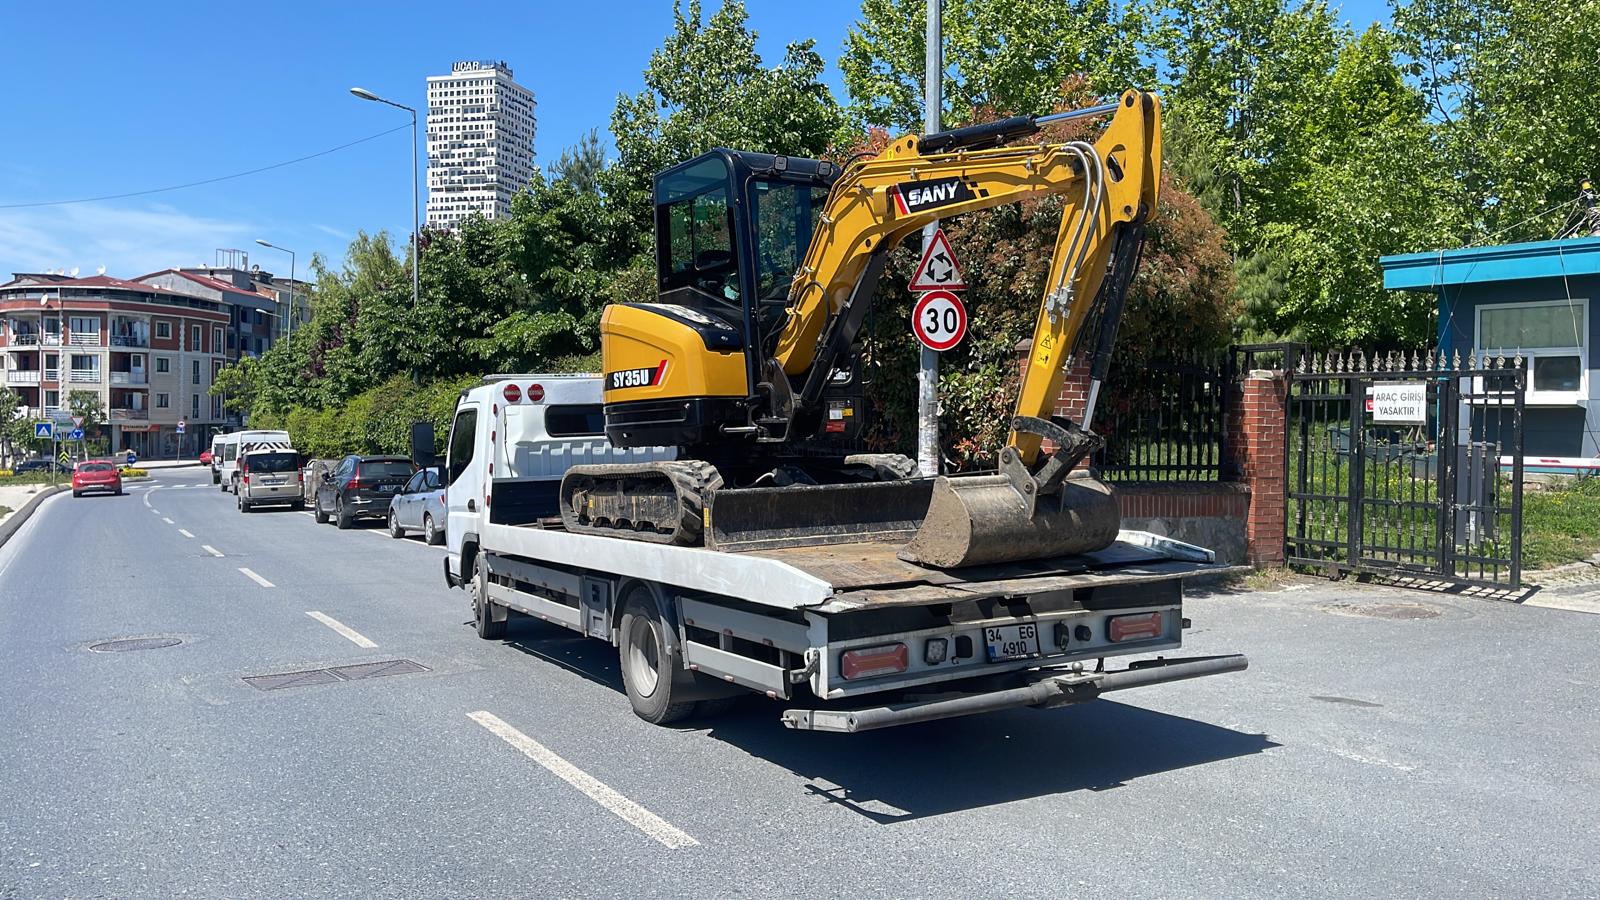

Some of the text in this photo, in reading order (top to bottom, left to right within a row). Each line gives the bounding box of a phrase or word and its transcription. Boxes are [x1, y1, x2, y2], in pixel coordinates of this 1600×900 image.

[909, 181, 959, 206] SANY
[926, 308, 957, 333] 30
[614, 369, 649, 387] SY35U
[1376, 391, 1424, 404] ARAÇ GİRİŞİ
[1379, 407, 1415, 416] YASAKTIR
[988, 626, 1034, 642] 34 EG
[1003, 641, 1027, 655] 4910
